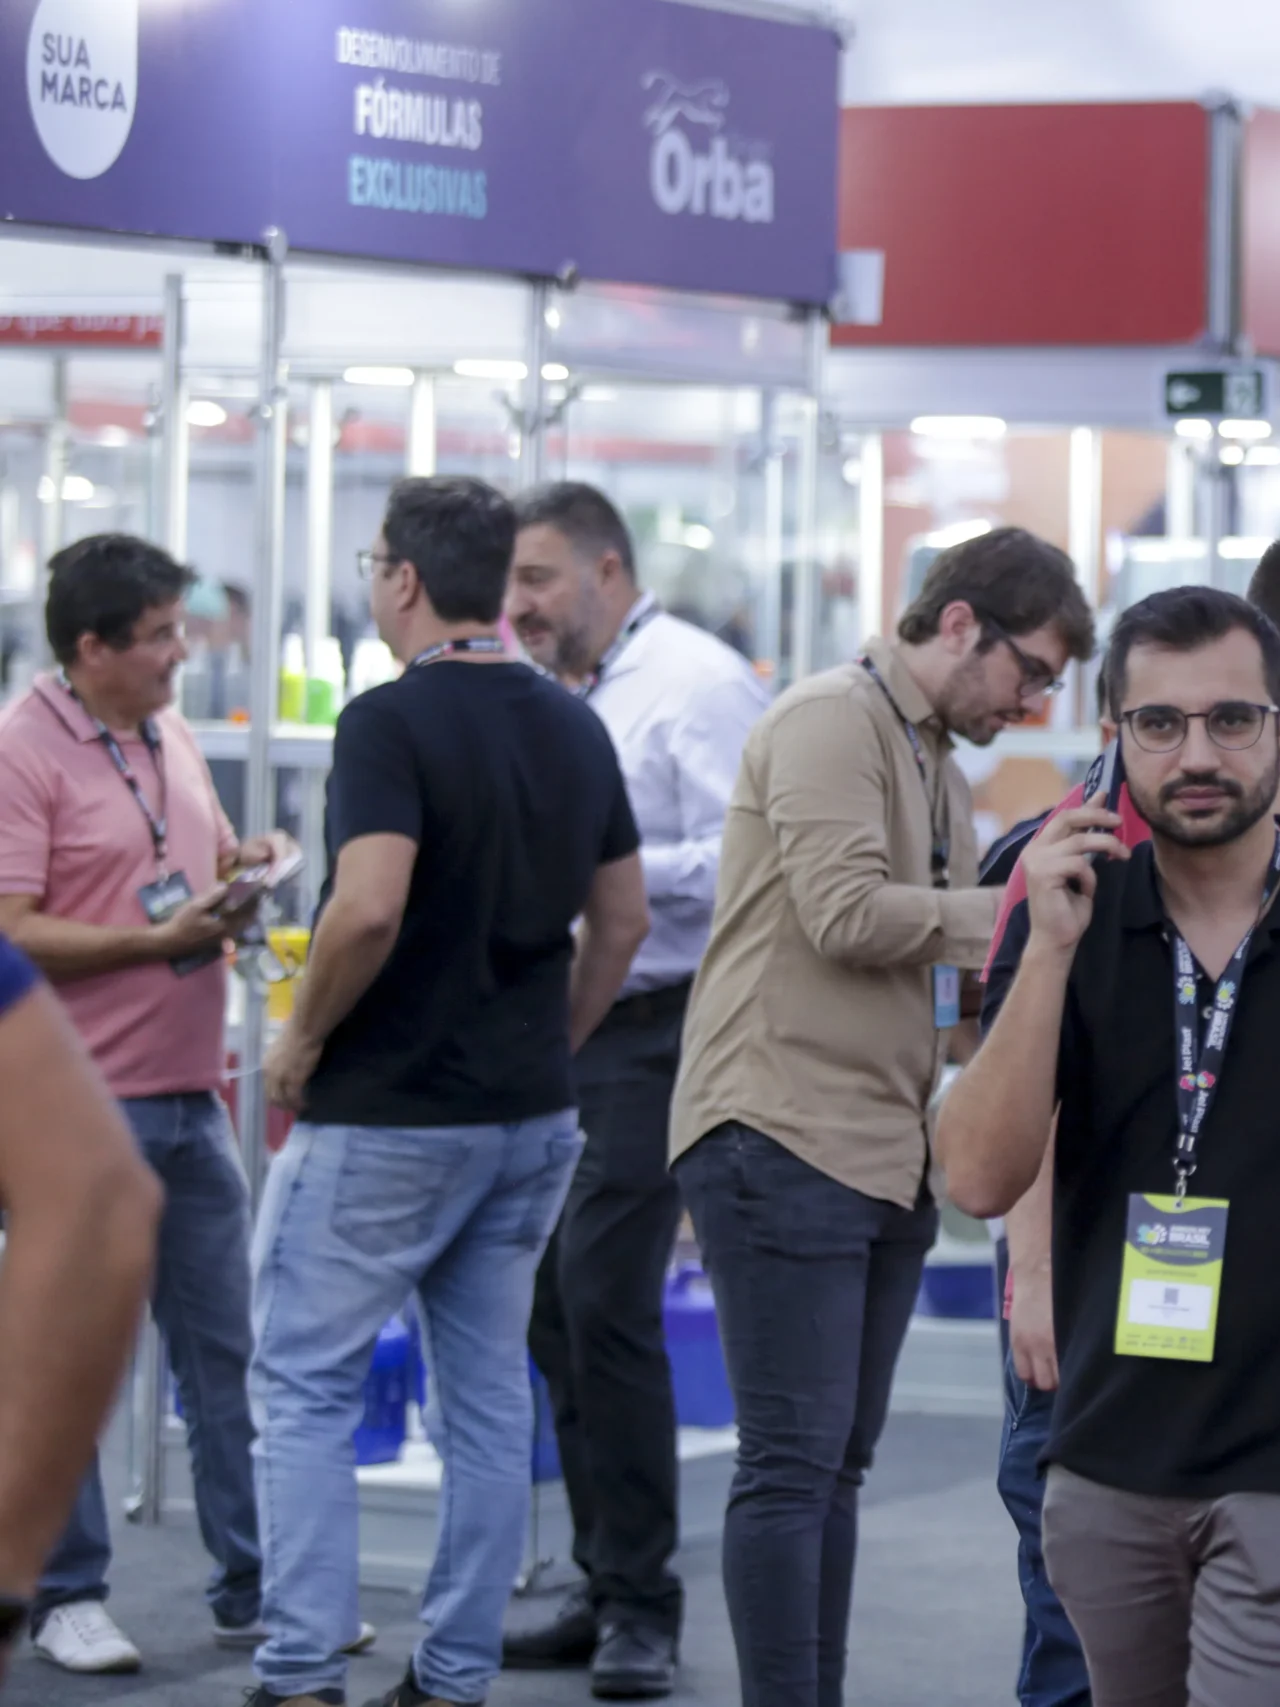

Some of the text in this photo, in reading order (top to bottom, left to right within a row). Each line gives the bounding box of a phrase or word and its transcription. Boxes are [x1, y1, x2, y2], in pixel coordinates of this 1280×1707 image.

[42, 32, 90, 70] SUA
[336, 25, 480, 83] DESENVOLVIMENTO
[41, 70, 127, 113] MARCA
[355, 75, 483, 151] FÓRMULAS
[349, 156, 488, 220] EXCLUSIVAS
[650, 128, 775, 224] Orba
